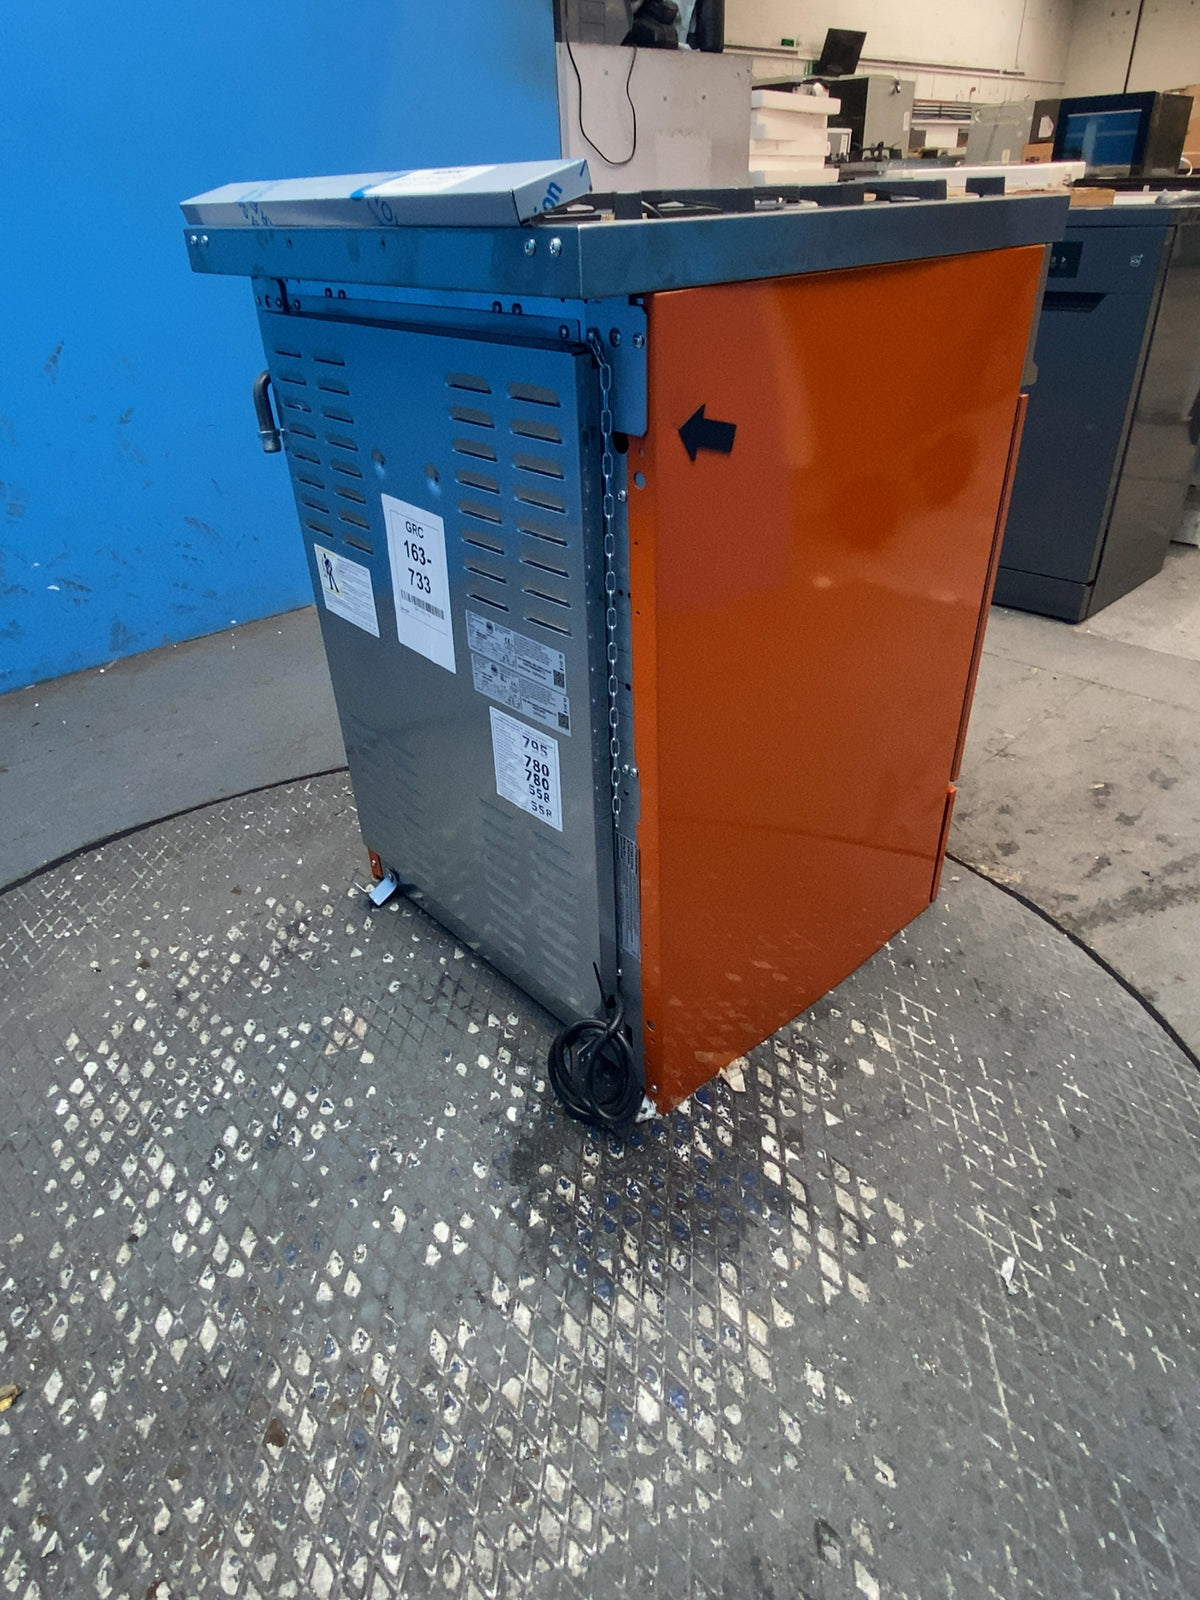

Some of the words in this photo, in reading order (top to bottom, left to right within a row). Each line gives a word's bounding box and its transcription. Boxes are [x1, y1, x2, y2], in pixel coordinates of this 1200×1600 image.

[405, 521, 424, 538] GRC
[404, 540, 432, 565] 163-
[408, 567, 432, 594] 733
[524, 754, 549, 777] 780
[525, 769, 549, 790] 780
[529, 785, 550, 803] 558
